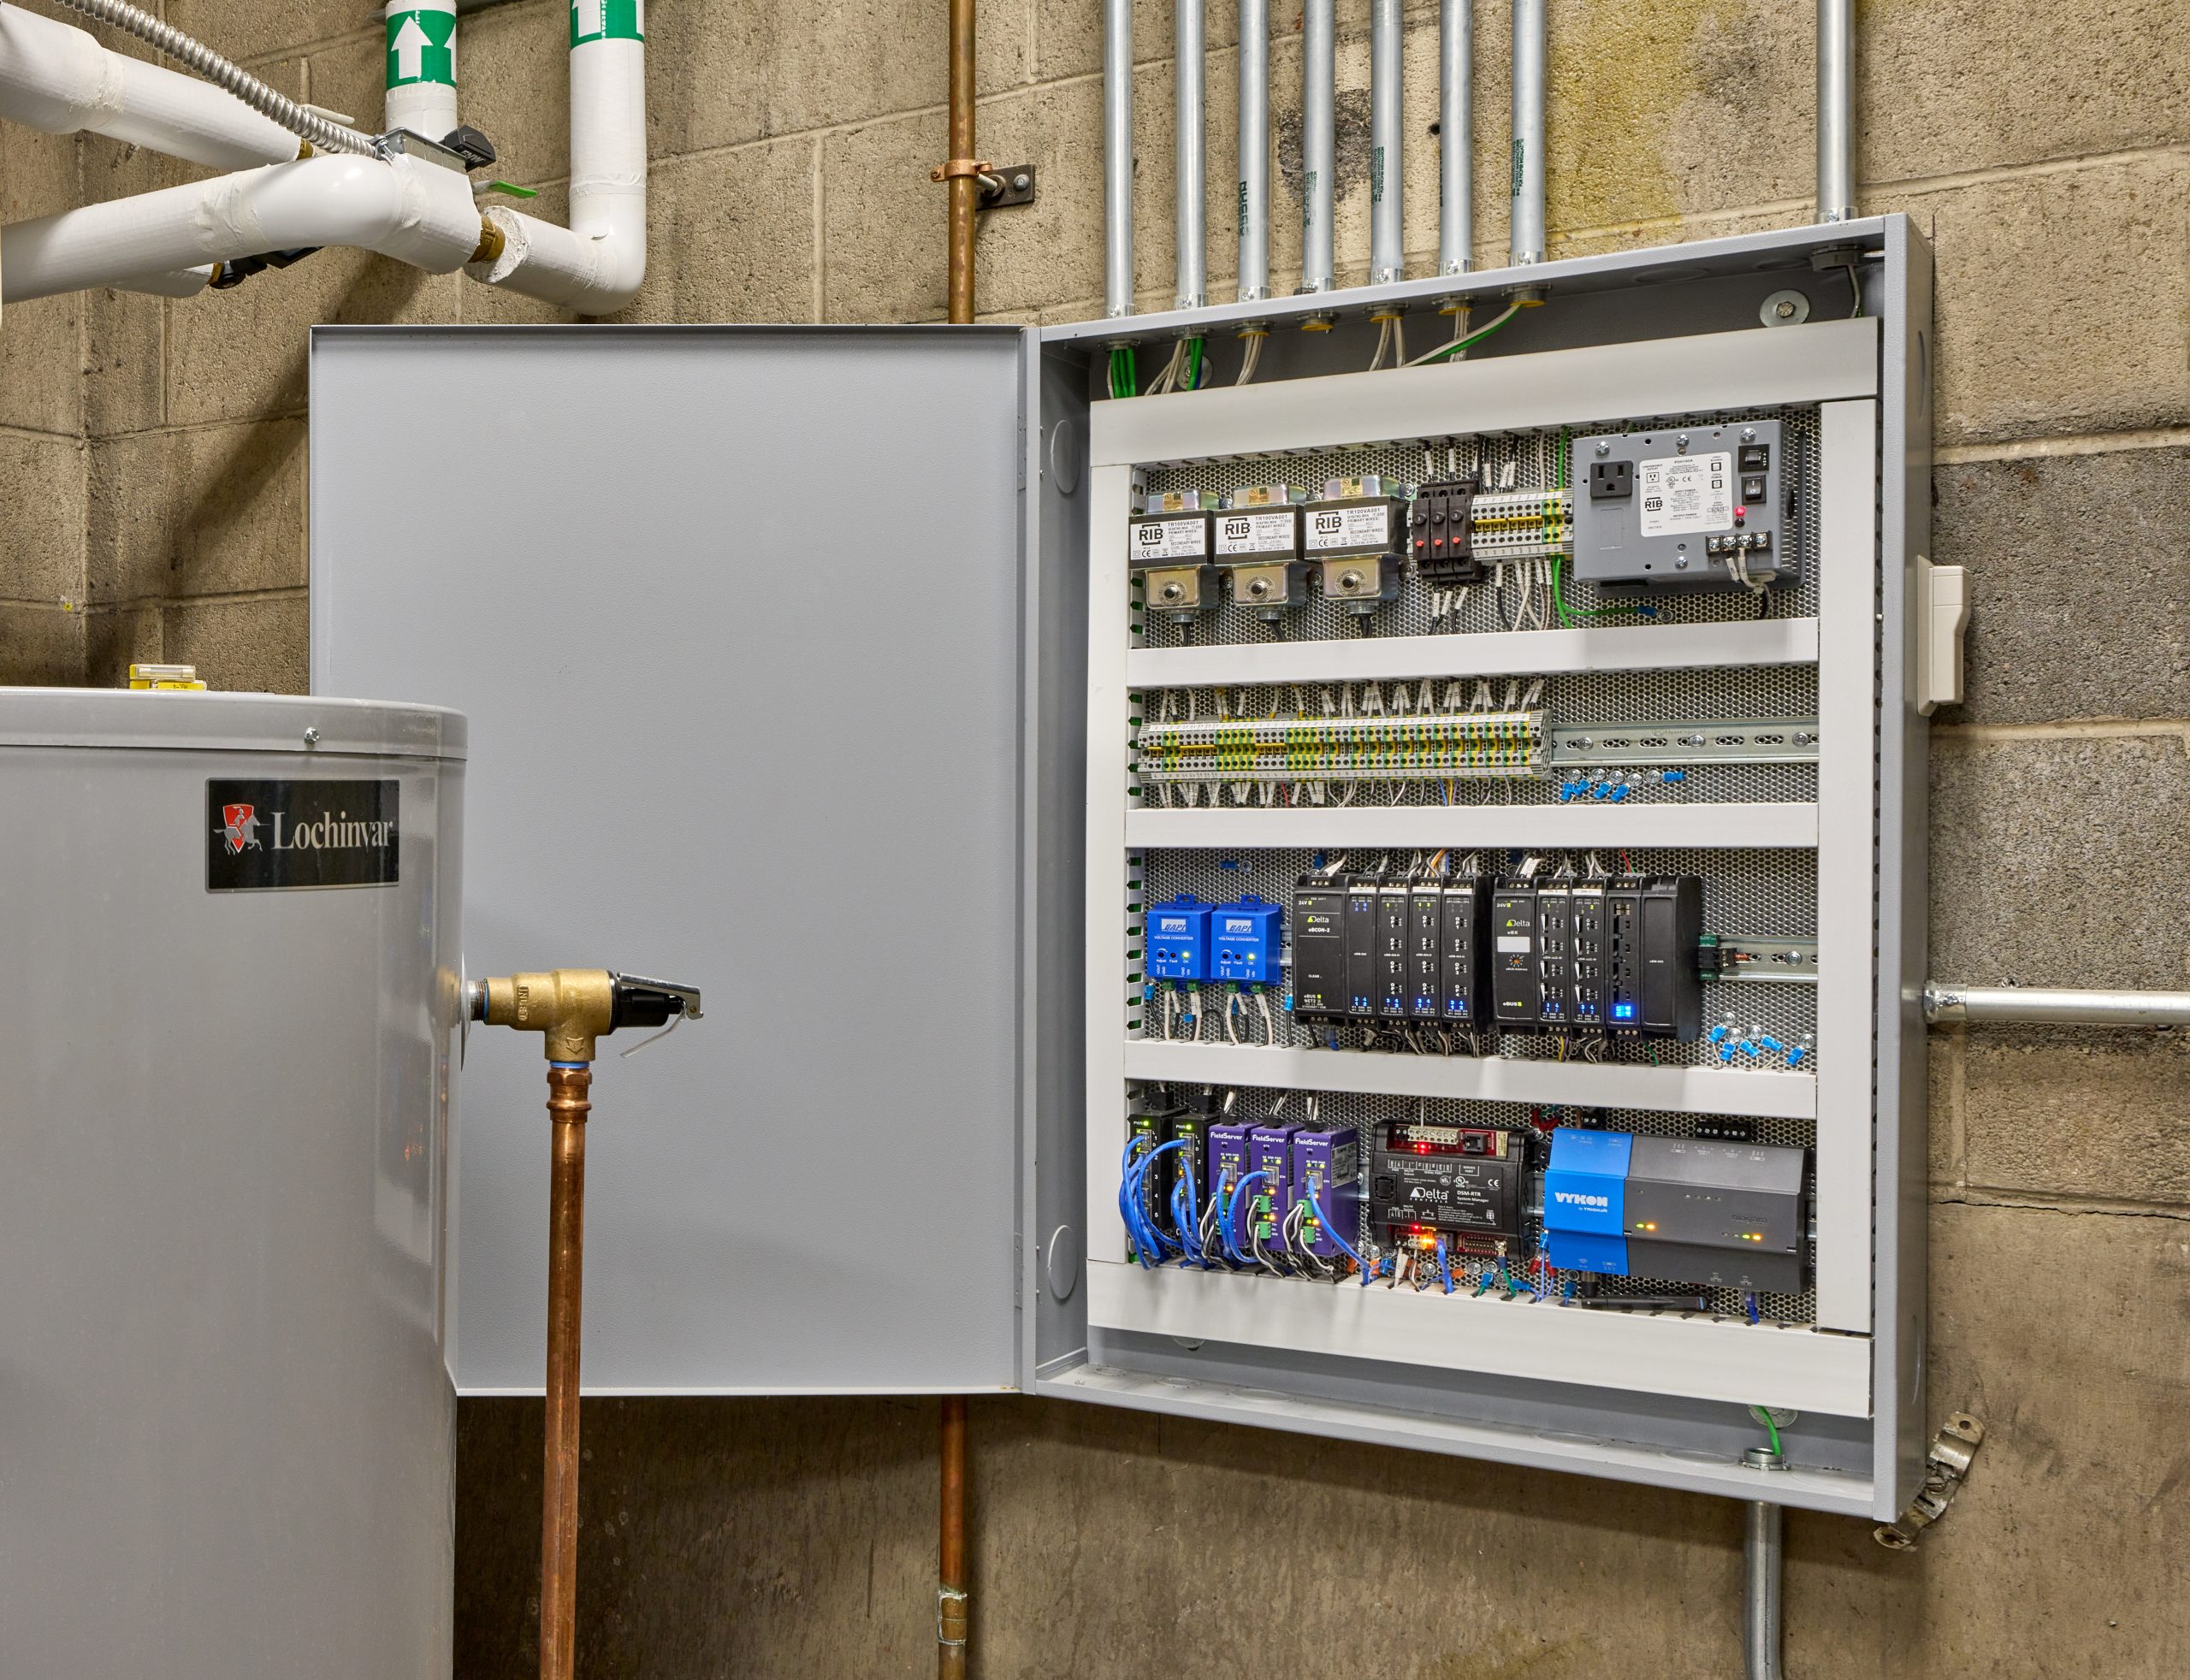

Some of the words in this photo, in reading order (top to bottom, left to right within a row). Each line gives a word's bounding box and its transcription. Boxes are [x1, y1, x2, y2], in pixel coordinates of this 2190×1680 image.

[1225, 523, 1251, 535] RIB
[1315, 517, 1341, 529] RIB
[1139, 529, 1163, 541] RIB
[270, 811, 393, 853] Lochinvar
[518, 985, 528, 1021] INLET
[1210, 1132, 1242, 1140] FieldServer
[1252, 1134, 1285, 1143] FieldServer
[1295, 1138, 1328, 1146] FieldServer
[1410, 1186, 1447, 1199] Delta
[1554, 1192, 1608, 1207] VYKON
